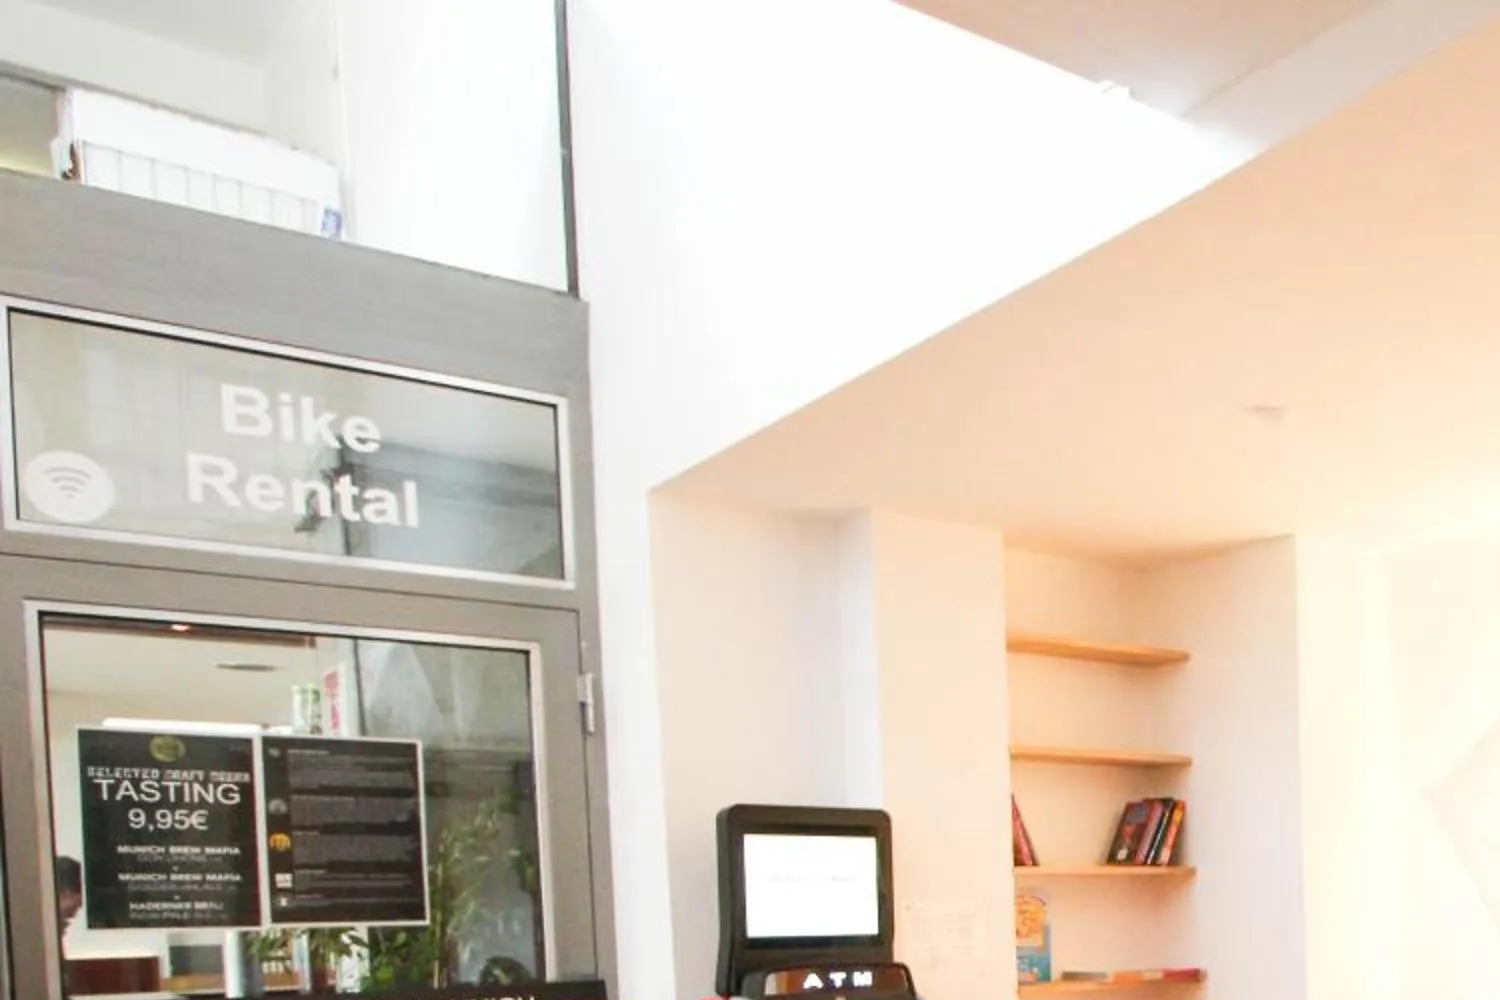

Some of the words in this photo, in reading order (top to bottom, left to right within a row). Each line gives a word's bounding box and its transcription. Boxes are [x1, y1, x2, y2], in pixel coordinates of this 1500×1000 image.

[220, 383, 382, 454] Bike
[185, 452, 419, 528] Rental
[93, 778, 241, 805] TASTING
[128, 808, 209, 832] 9,95€
[803, 971, 873, 989] ATM
